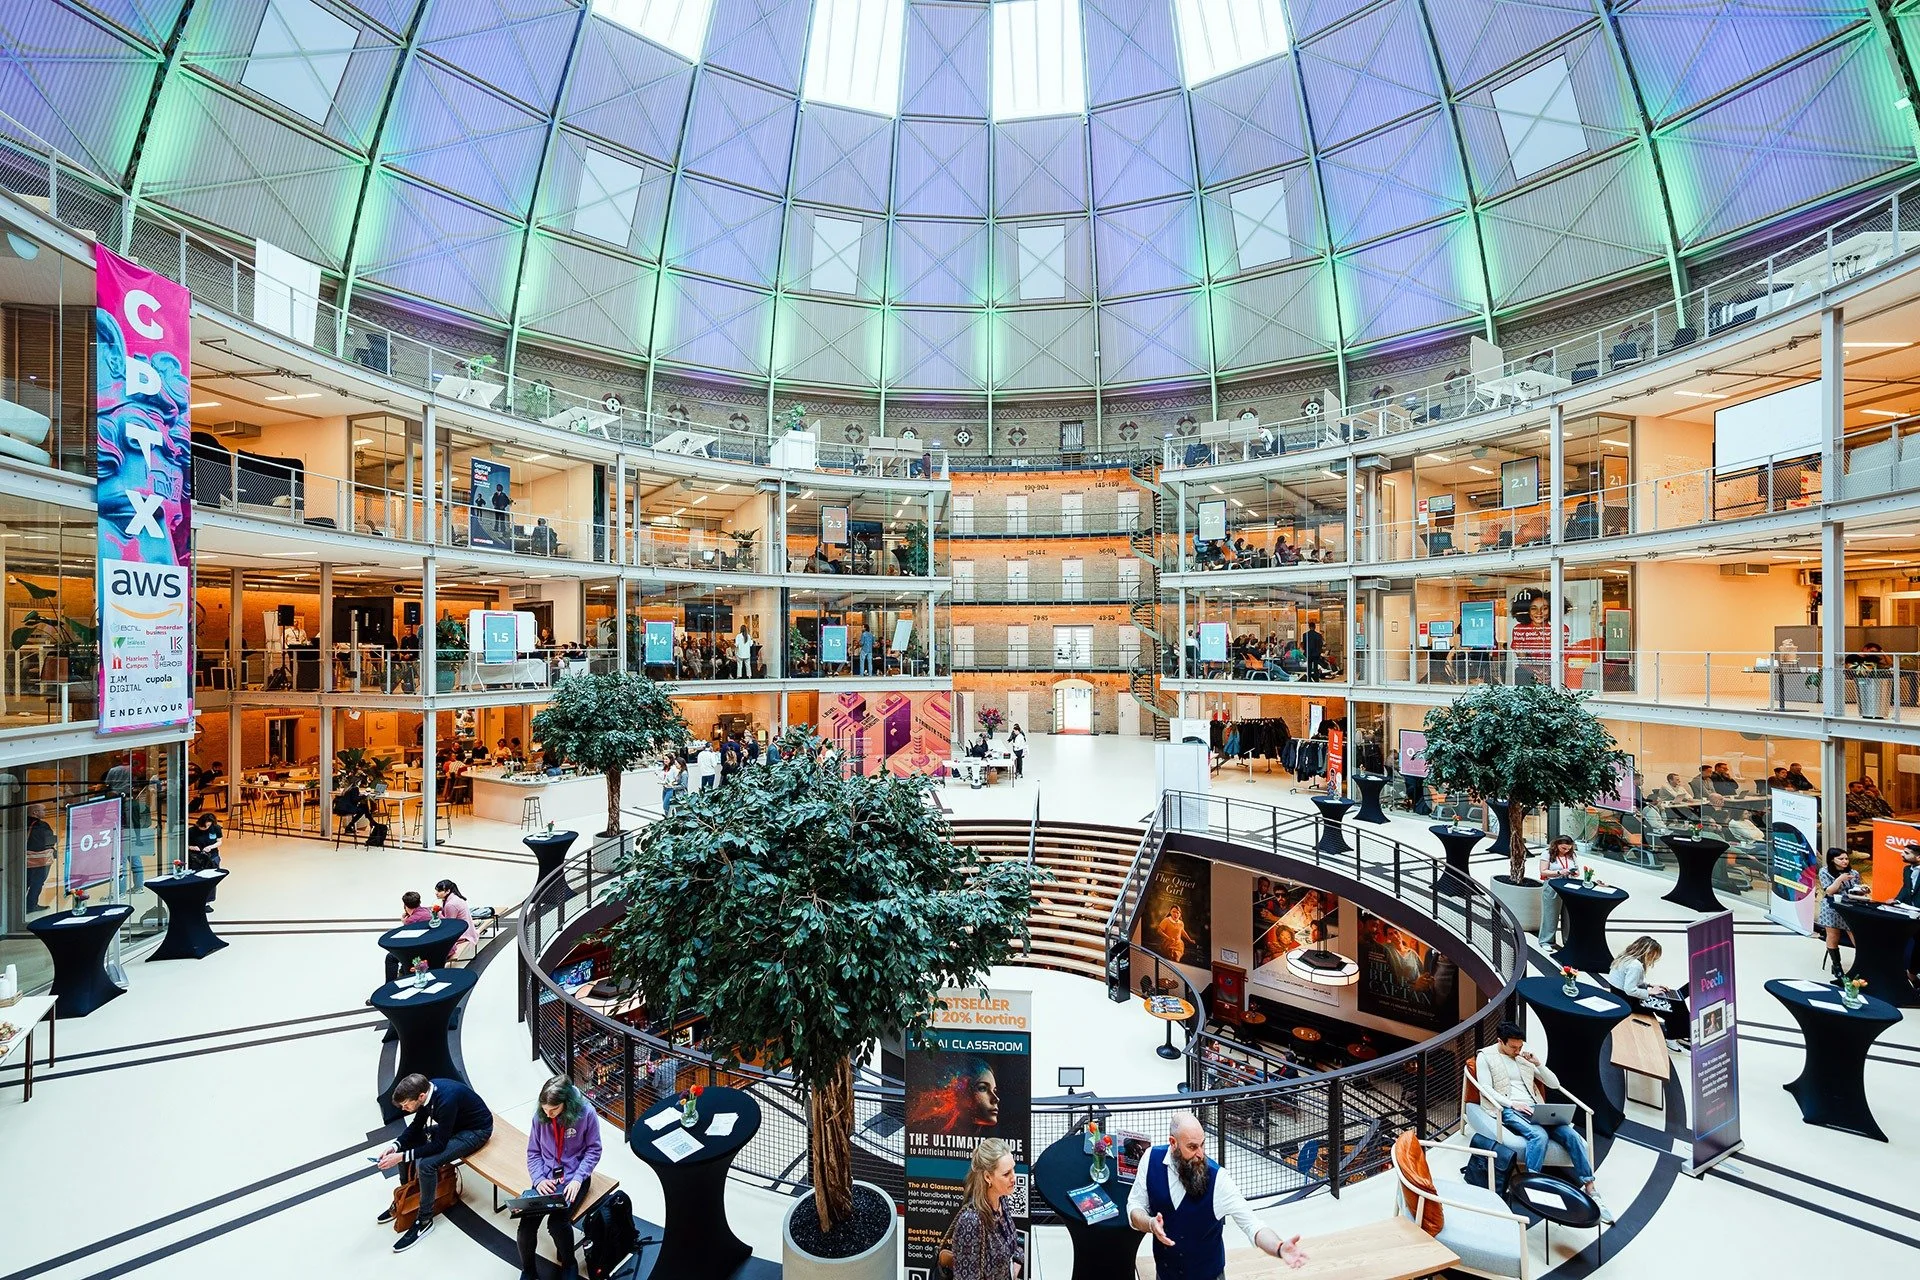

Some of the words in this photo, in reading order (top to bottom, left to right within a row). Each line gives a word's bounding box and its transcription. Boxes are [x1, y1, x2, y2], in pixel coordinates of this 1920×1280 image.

[1511, 476, 1528, 489] 2.1
[1610, 475, 1622, 486] 2.1
[827, 520, 842, 529] 2.3
[1204, 515, 1220, 525] 2.2
[111, 569, 181, 598] aws
[1470, 617, 1485, 628] 1.1
[492, 632, 509, 642] 1.5
[1612, 628, 1623, 638] 1.1
[828, 638, 842, 647] 1.3
[1206, 636, 1220, 645] 1.2
[146, 674, 172, 684] cupola
[109, 684, 142, 693] DIGITAL
[110, 703, 183, 717] ENDEAVOUR
[80, 829, 111, 852] 0.3
[1885, 835, 1919, 847] aws
[1155, 873, 1170, 883] The
[1171, 875, 1196, 889] Quiet
[1165, 884, 1185, 895] Girl
[1369, 961, 1391, 972] THE
[1701, 971, 1724, 992] Peech
[928, 996, 1010, 1011] STSELLER
[942, 1011, 972, 1023] 20%
[975, 1013, 1027, 1029] korting
[952, 1039, 1023, 1051] CLASSROOM
[909, 1133, 929, 1146] THE
[918, 1148, 946, 1157] Artificial
[929, 1183, 965, 1191] Classroom
[920, 1190, 952, 1199] handboek
[908, 1198, 945, 1207] generatieve
[919, 1206, 951, 1215] onderwijs.
